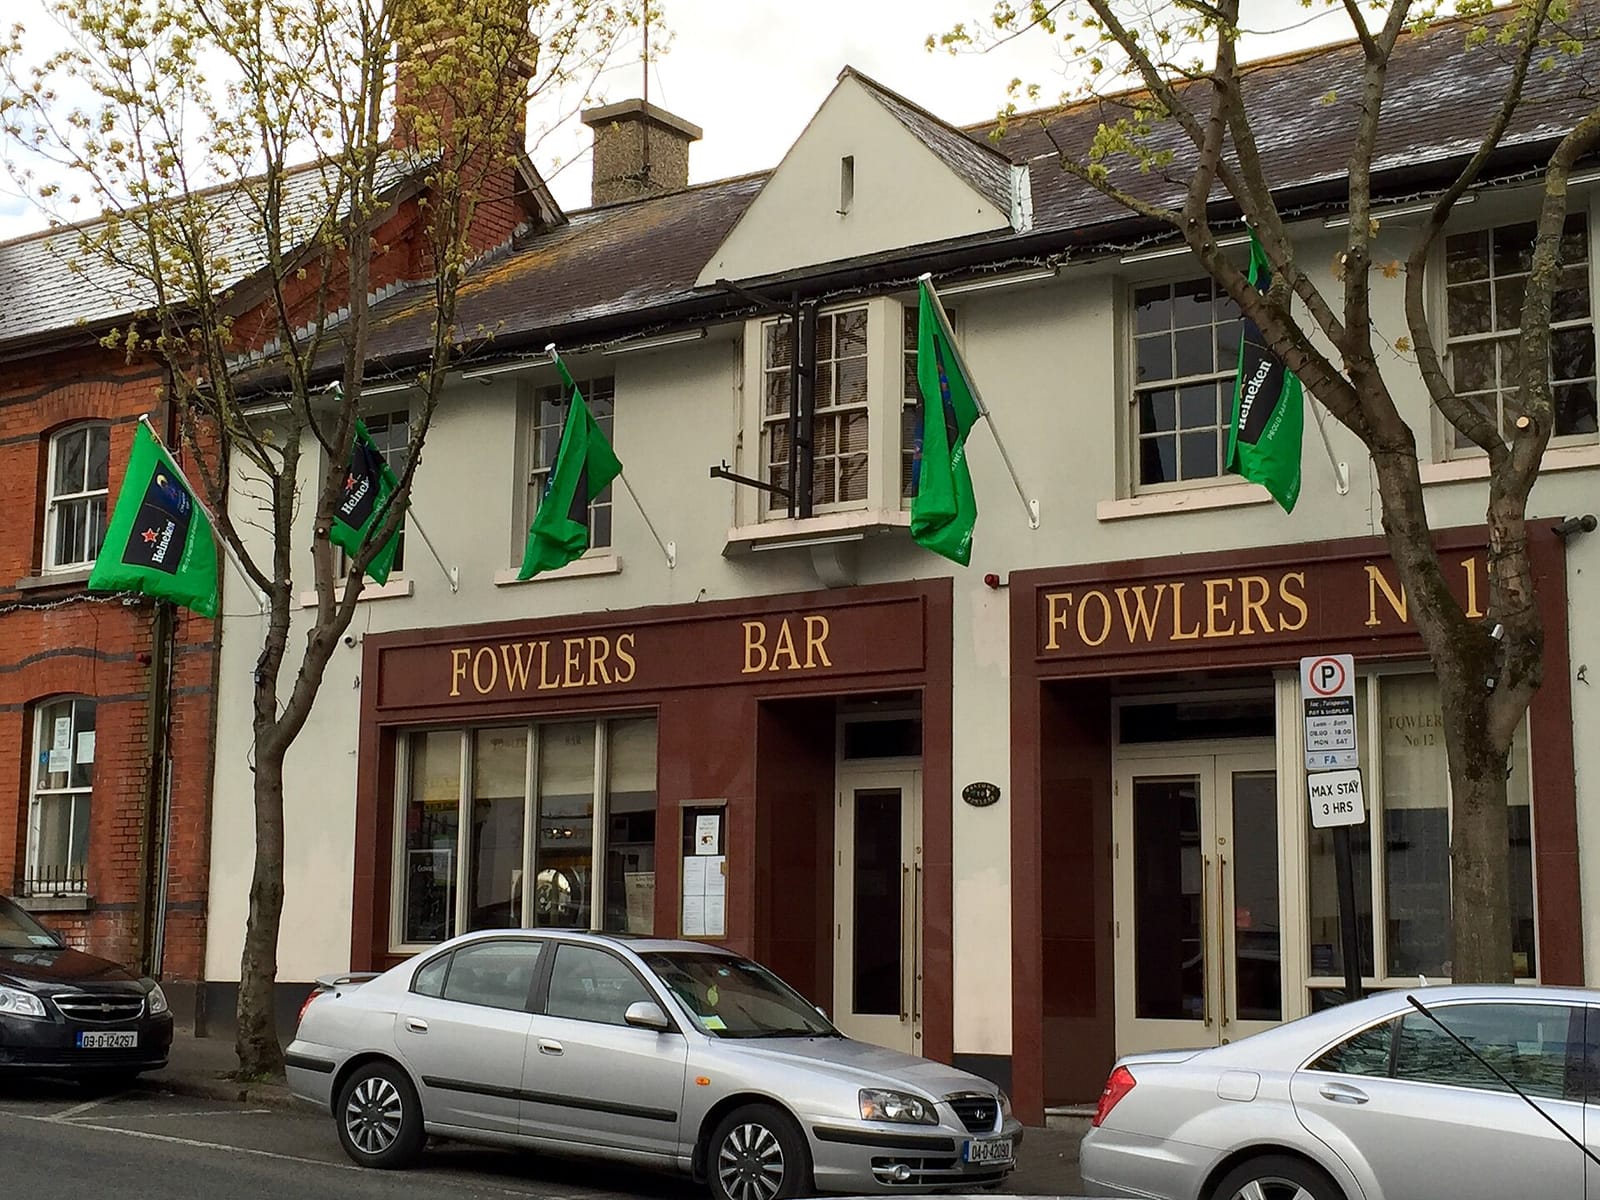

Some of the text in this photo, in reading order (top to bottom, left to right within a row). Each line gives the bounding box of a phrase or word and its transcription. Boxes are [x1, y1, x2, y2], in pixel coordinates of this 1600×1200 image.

[151, 521, 176, 563] Heineken
[1044, 571, 1308, 650] FOWLERS
[1460, 557, 1491, 619] 1
[448, 614, 833, 697] FOWLERS BAR
[1321, 665, 1336, 689] P
[1422, 734, 1435, 746] 12
[1324, 755, 1338, 765] FA
[1311, 781, 1360, 799] MAX STAY
[1322, 801, 1354, 816] 3 HRS
